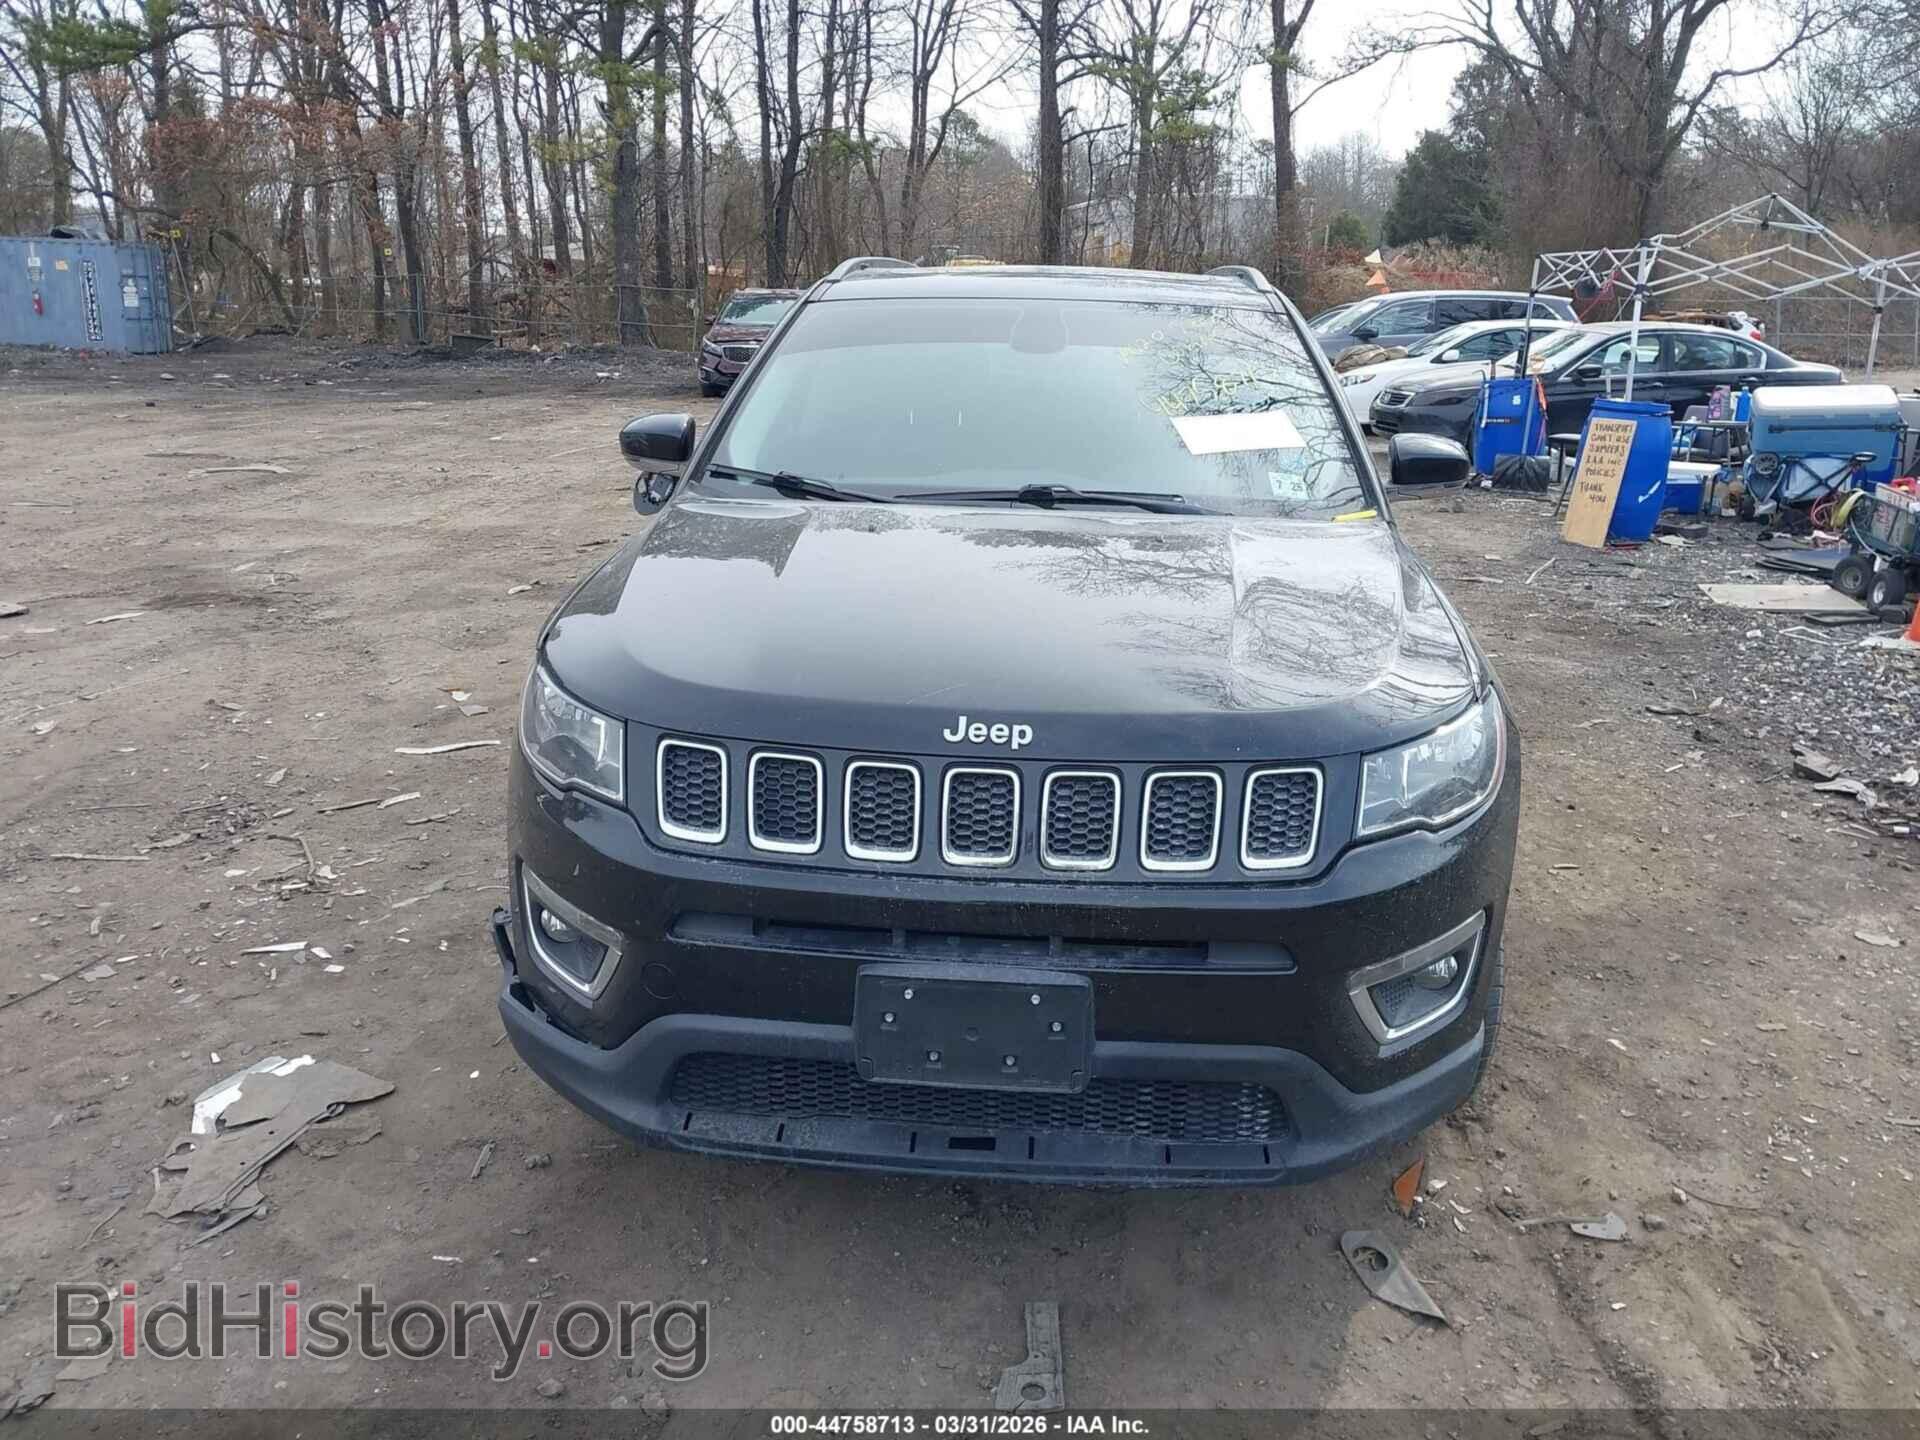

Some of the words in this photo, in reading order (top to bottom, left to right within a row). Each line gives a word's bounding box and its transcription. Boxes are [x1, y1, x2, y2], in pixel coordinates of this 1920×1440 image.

[1290, 481, 1303, 491] 25
[1589, 494, 1607, 503] YOU
[943, 715, 1033, 750] Jeep
